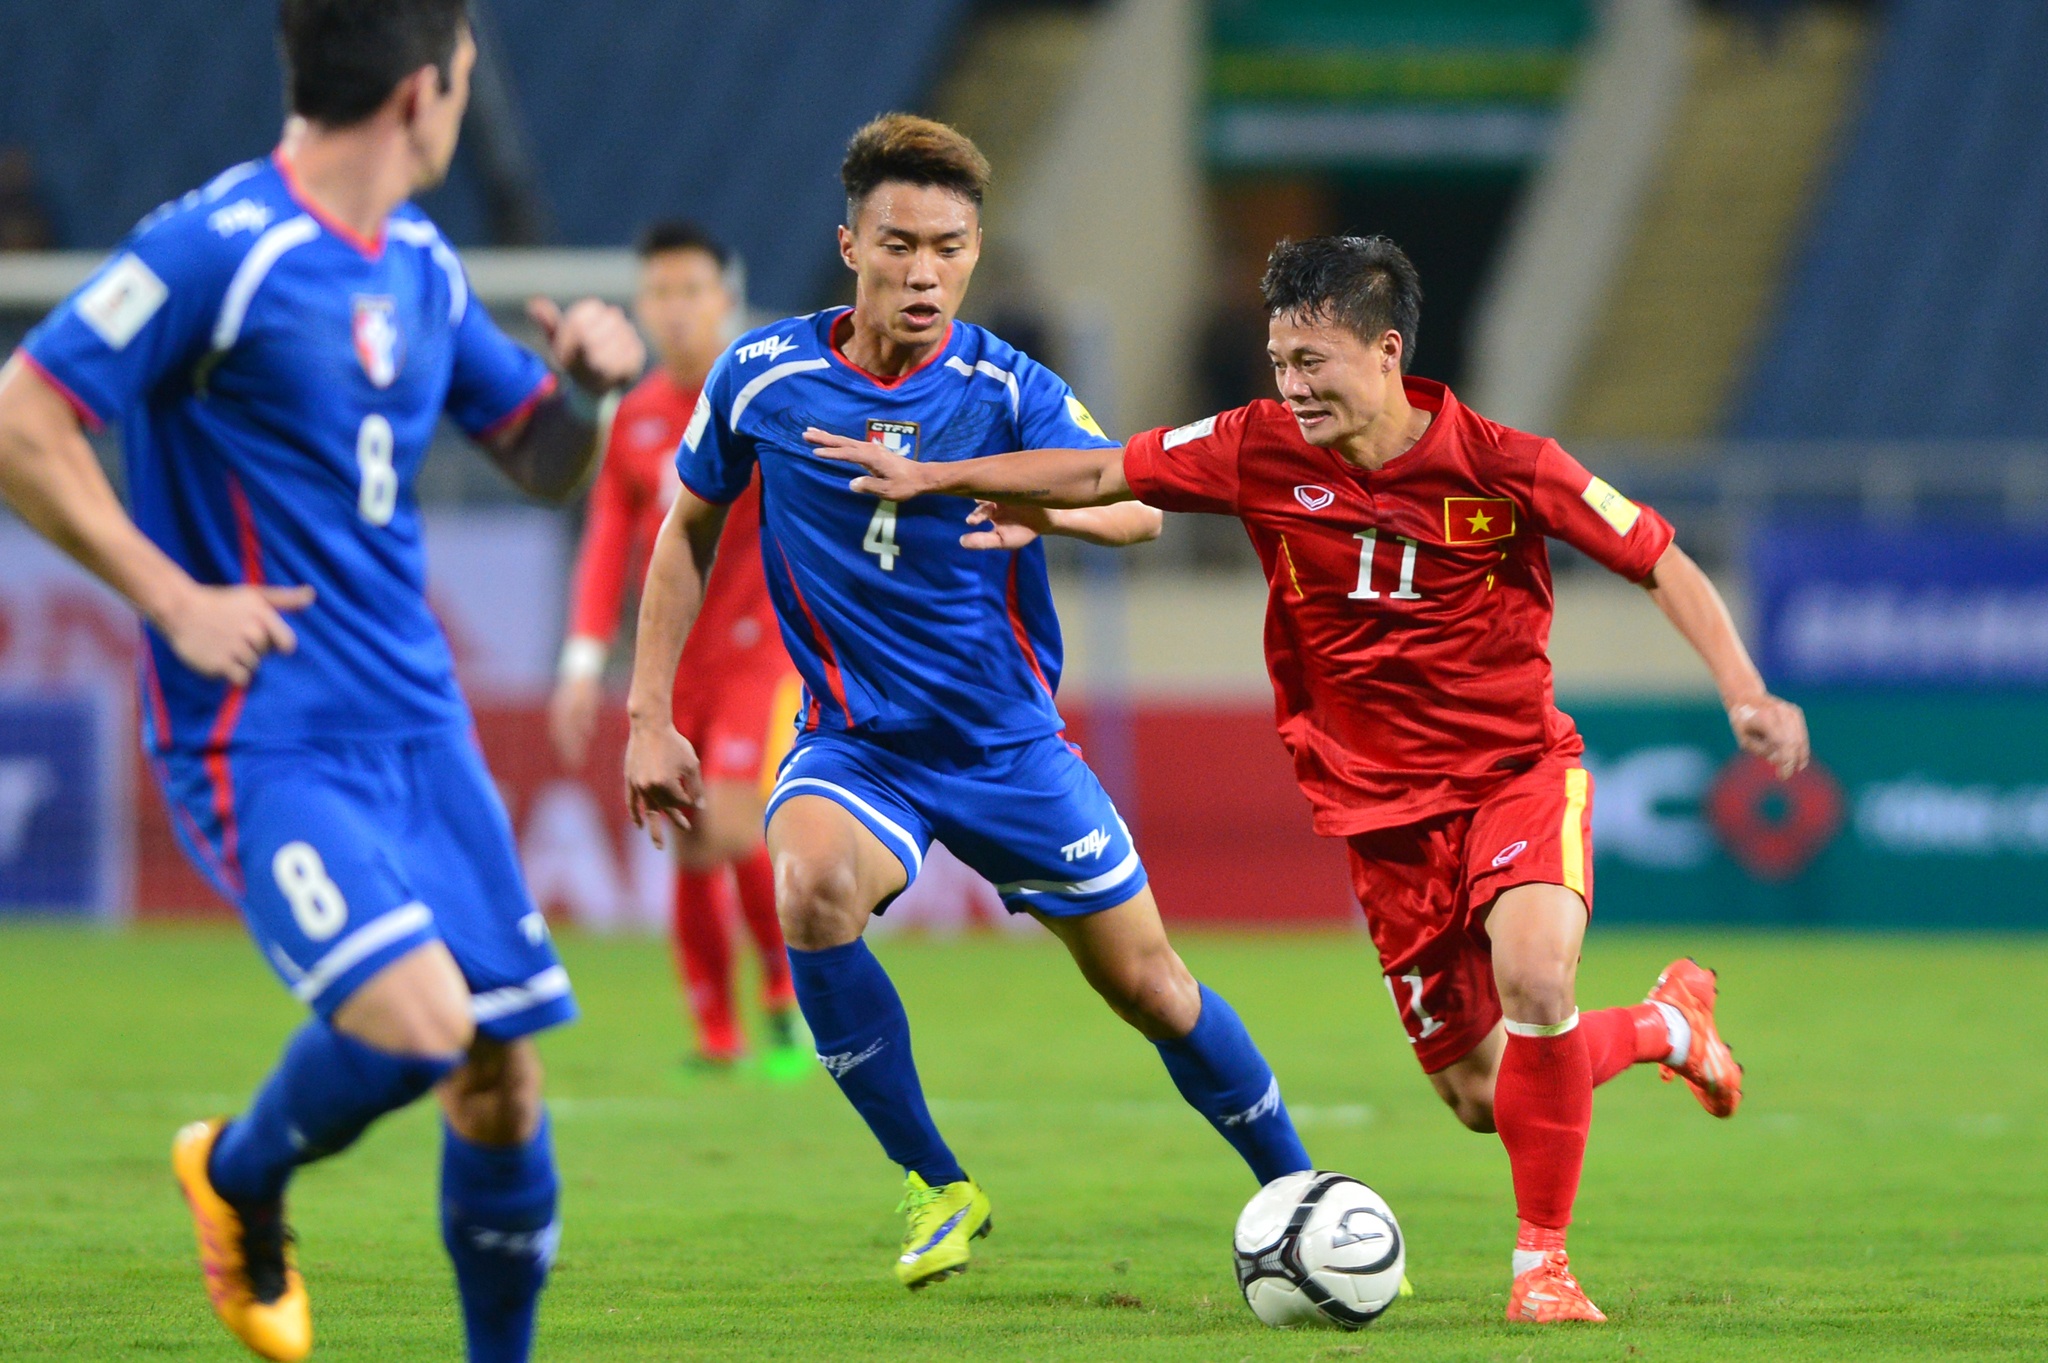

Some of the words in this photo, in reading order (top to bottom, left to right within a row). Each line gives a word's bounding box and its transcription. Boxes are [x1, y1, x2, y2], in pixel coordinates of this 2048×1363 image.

[357, 413, 398, 526] 8
[863, 499, 900, 571] 4
[1347, 527, 1421, 598] 11
[272, 840, 349, 941] 8
